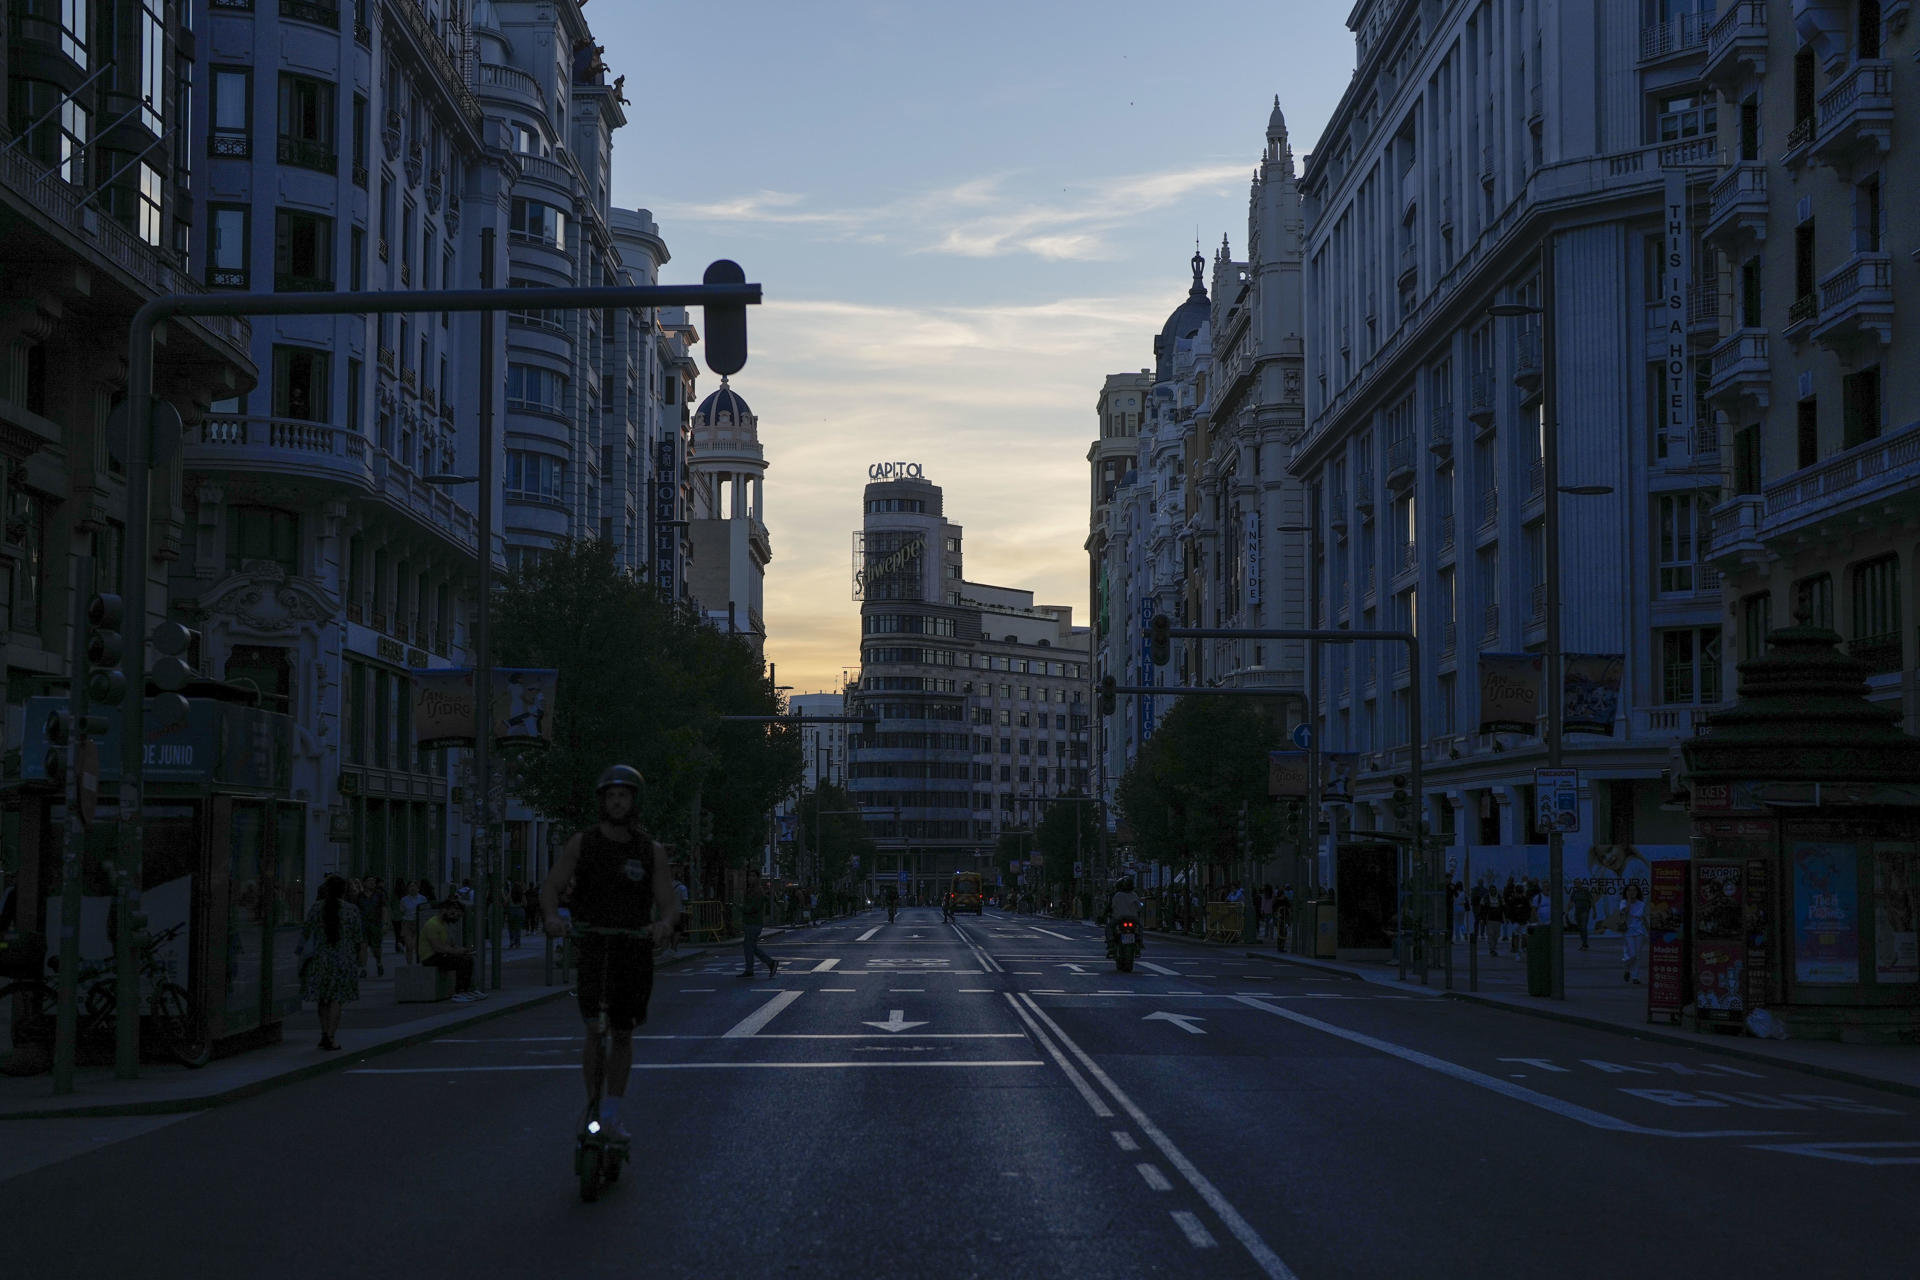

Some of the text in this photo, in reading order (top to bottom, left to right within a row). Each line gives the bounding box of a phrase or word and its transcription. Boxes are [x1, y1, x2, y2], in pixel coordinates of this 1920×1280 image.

[1669, 205, 1683, 425] THIS IS A HOTEL
[868, 462, 925, 480] CAPITOL
[659, 471, 674, 550] HOTEL
[1143, 599, 1152, 648] HOTL
[143, 744, 193, 765] DE JUNIO
[1564, 886, 1617, 896] VANO
[1496, 1056, 1768, 1078] TAXI
[1616, 1087, 1909, 1116] BUS
